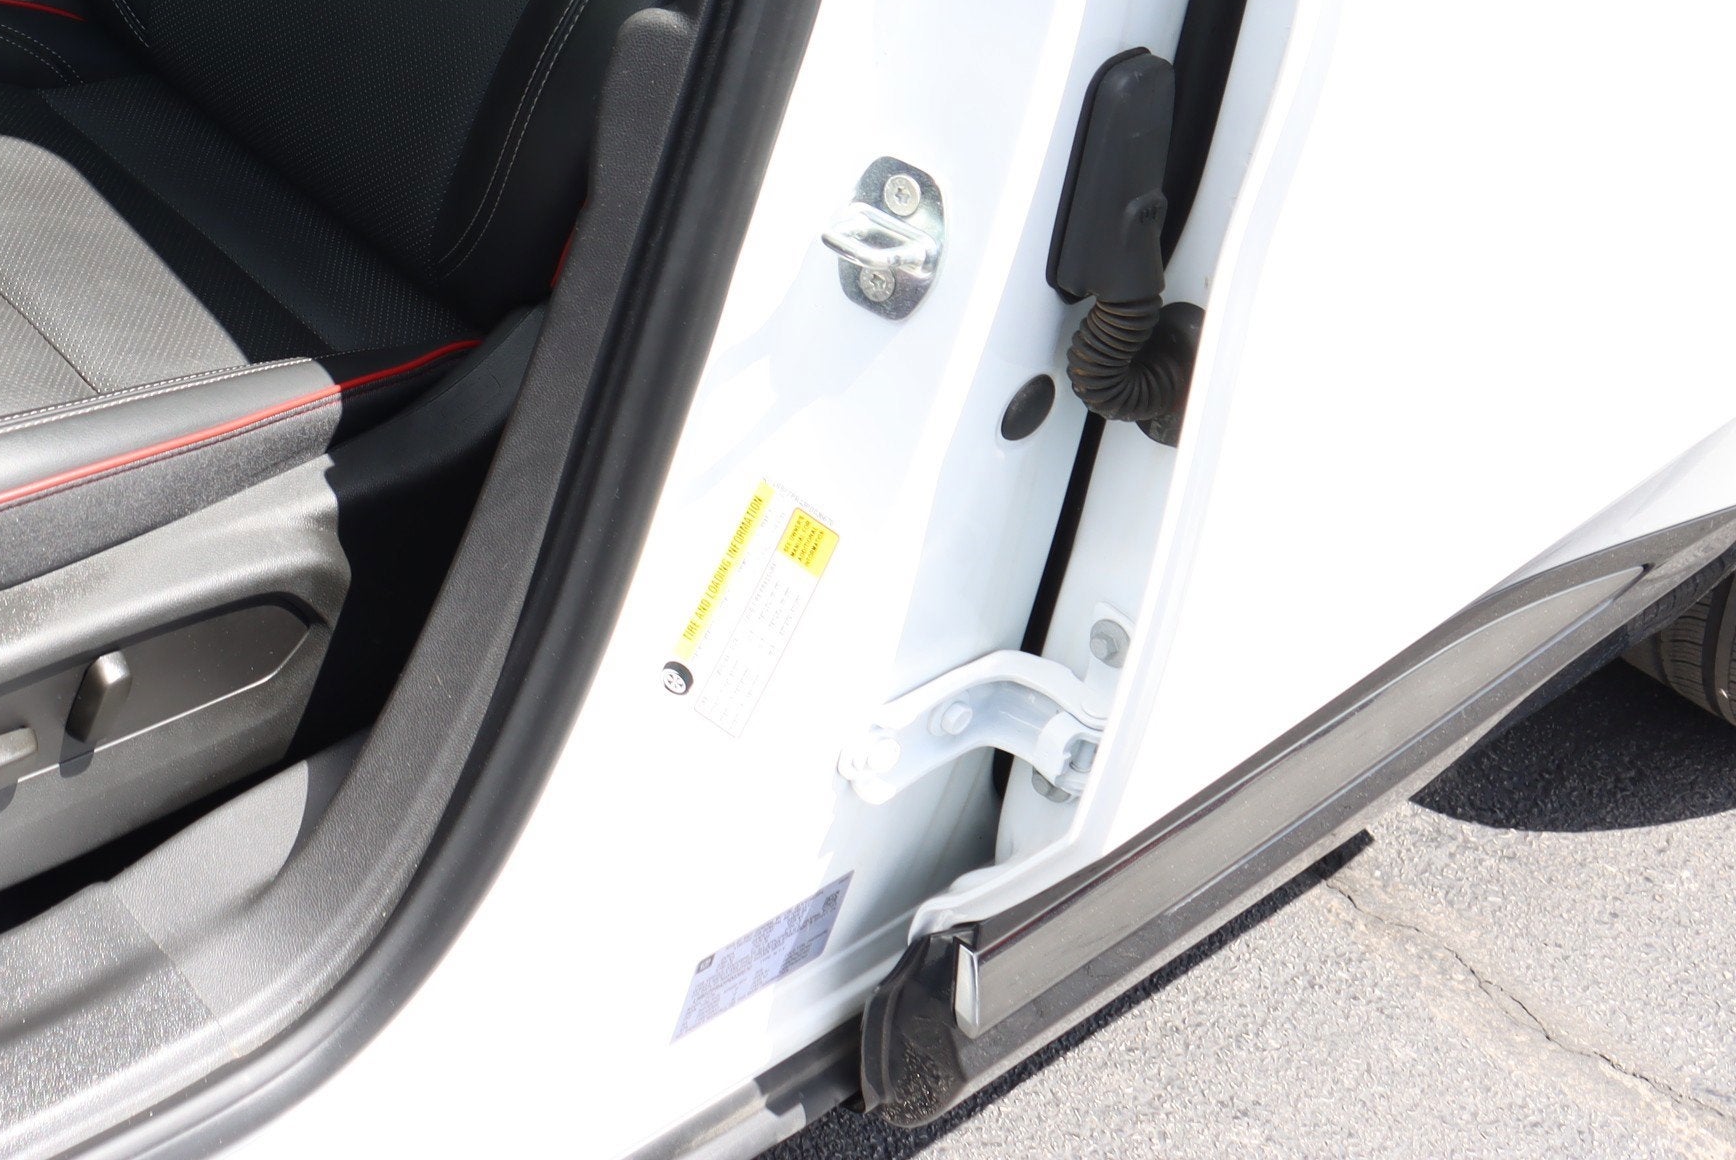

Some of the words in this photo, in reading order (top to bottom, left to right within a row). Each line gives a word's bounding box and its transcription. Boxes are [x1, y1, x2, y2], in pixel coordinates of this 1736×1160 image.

[683, 619, 701, 641] TIRE
[695, 598, 712, 620] AND
[706, 558, 732, 599] LOADING
[726, 495, 763, 558] INFORMATION
